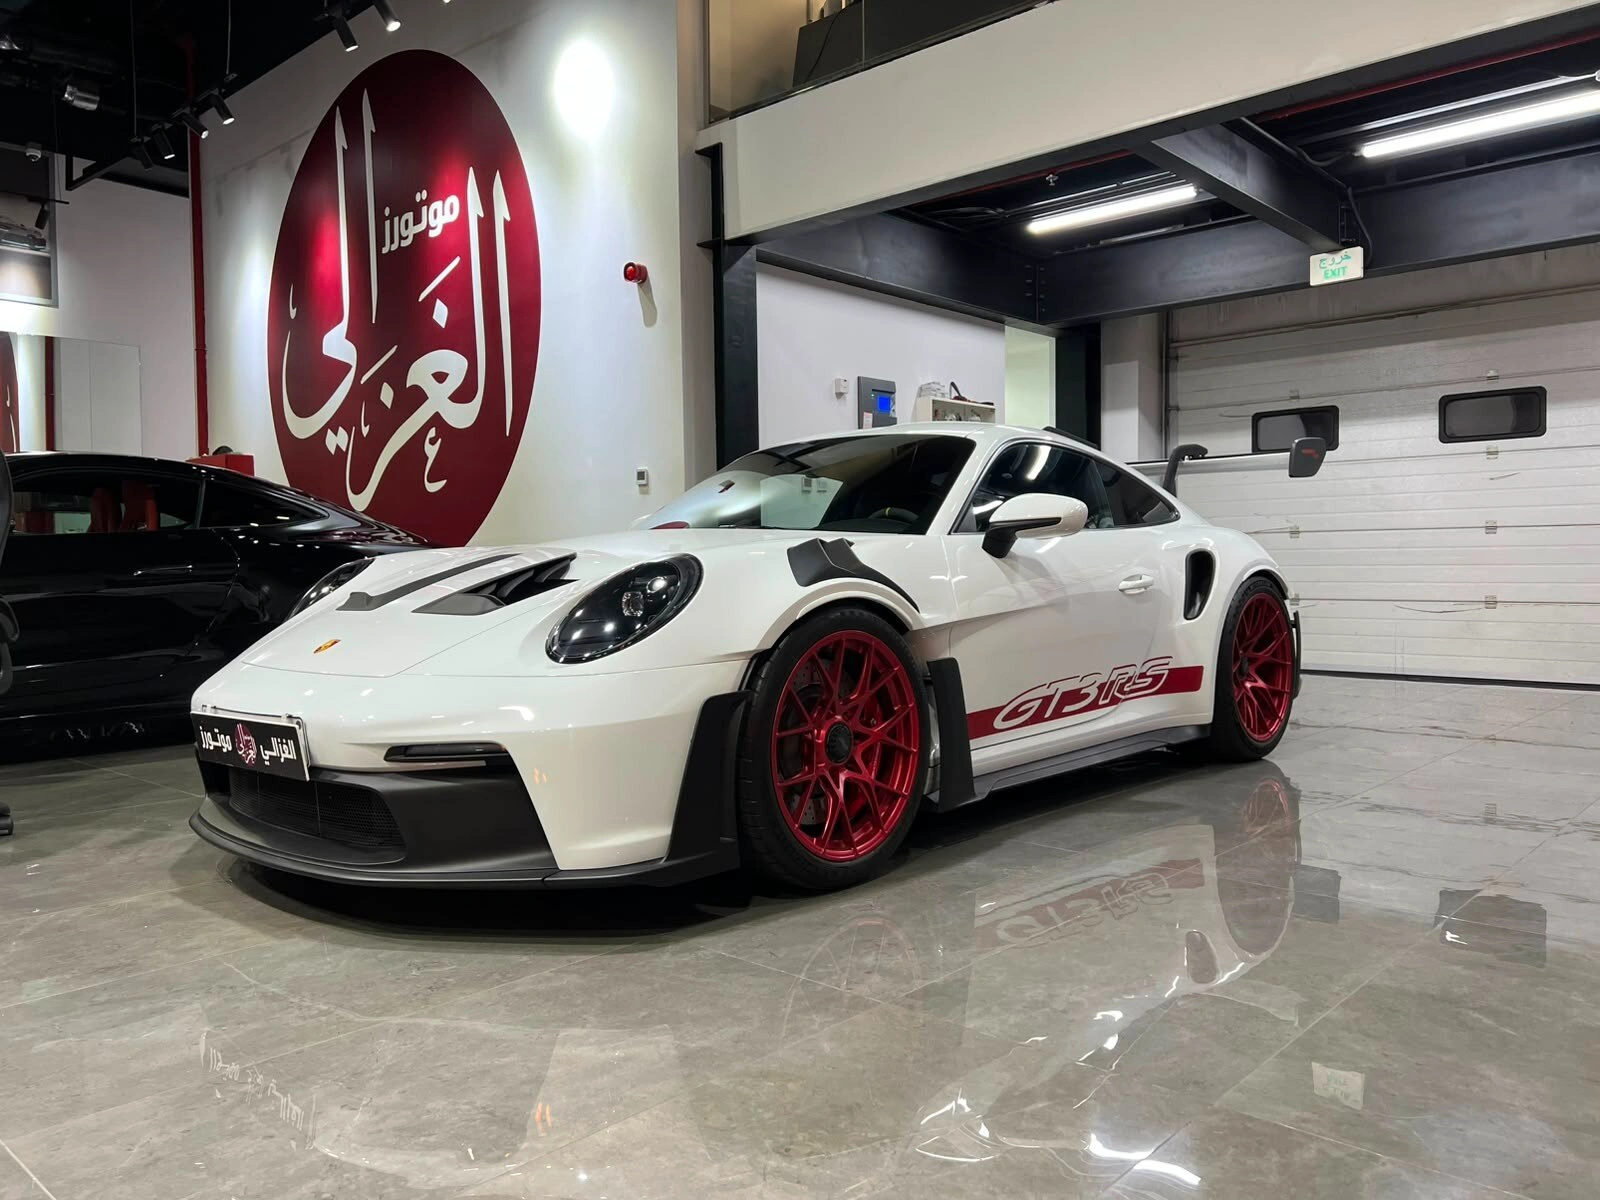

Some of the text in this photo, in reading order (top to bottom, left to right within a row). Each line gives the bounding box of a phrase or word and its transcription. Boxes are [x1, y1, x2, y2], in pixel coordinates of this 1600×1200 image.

[381, 190, 460, 253] موتورز
[1319, 251, 1352, 269] خروج
[1324, 266, 1348, 279] EXIT
[200, 726, 297, 766] الغزالي موتورز
